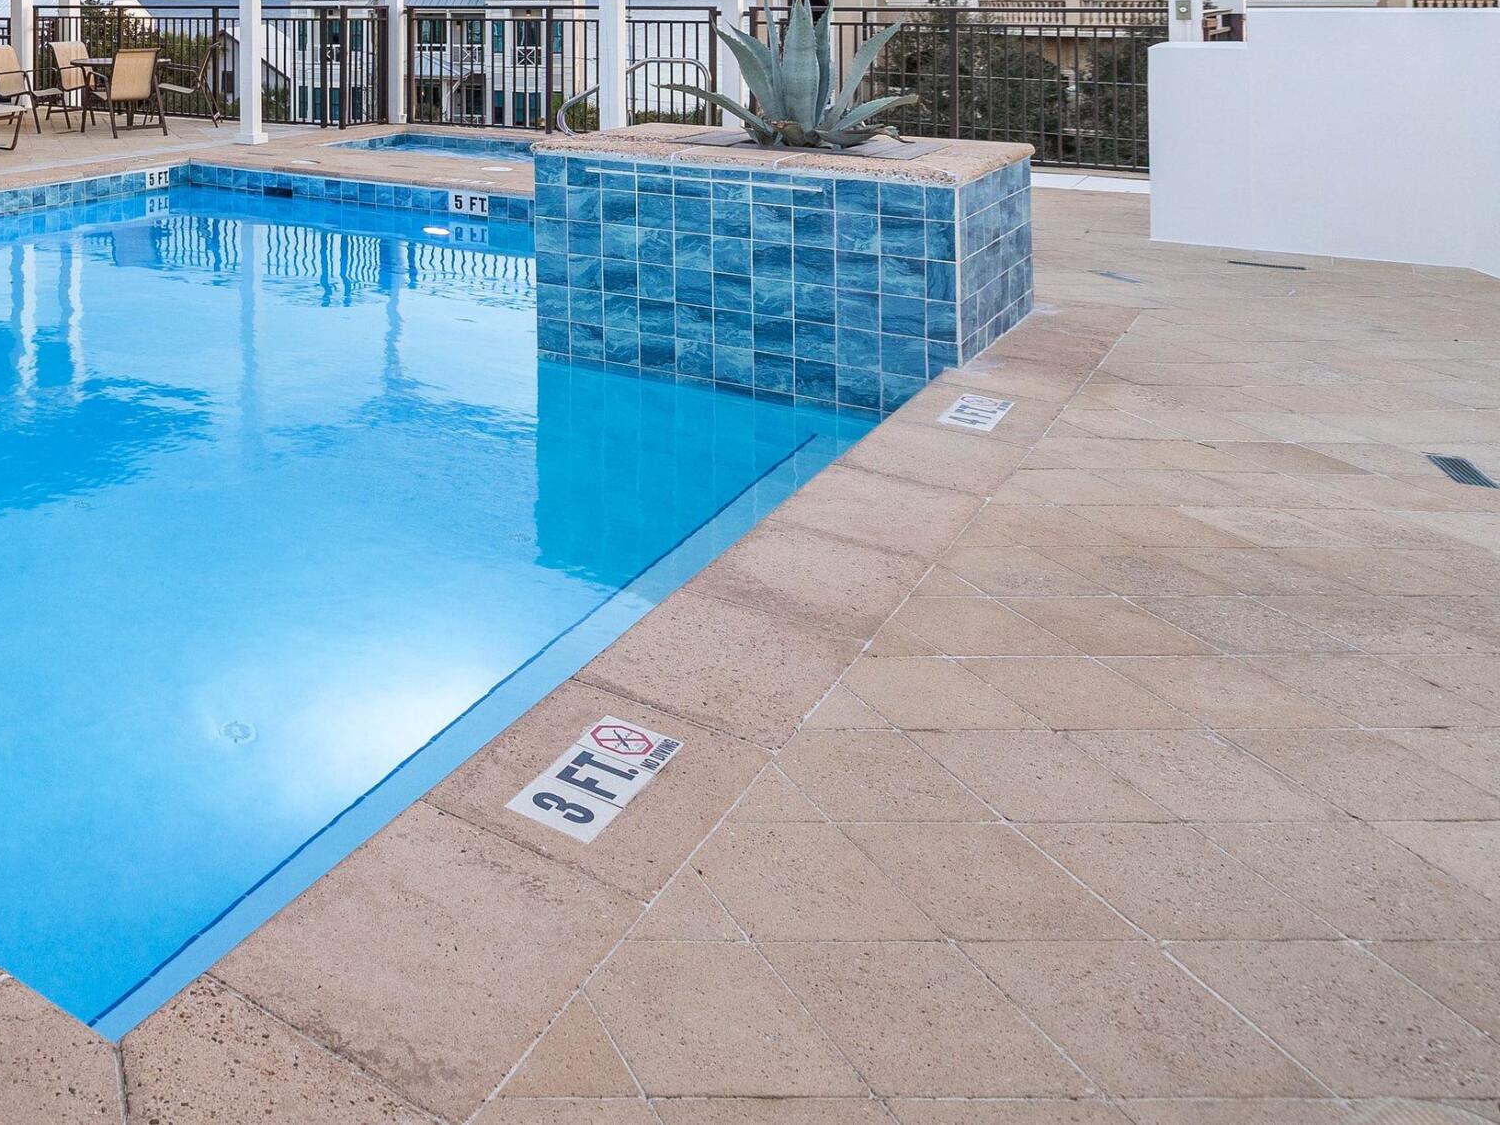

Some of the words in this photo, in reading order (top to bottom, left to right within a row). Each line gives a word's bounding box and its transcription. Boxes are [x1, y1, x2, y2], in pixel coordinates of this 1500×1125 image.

[149, 173, 154, 186] 5
[454, 195, 463, 210] 5
[469, 196, 487, 213] FT.
[948, 416, 987, 425] 4
[641, 759, 660, 772] NO
[658, 739, 680, 762] DIVING
[555, 749, 640, 801] FT.
[532, 791, 596, 825] 3
